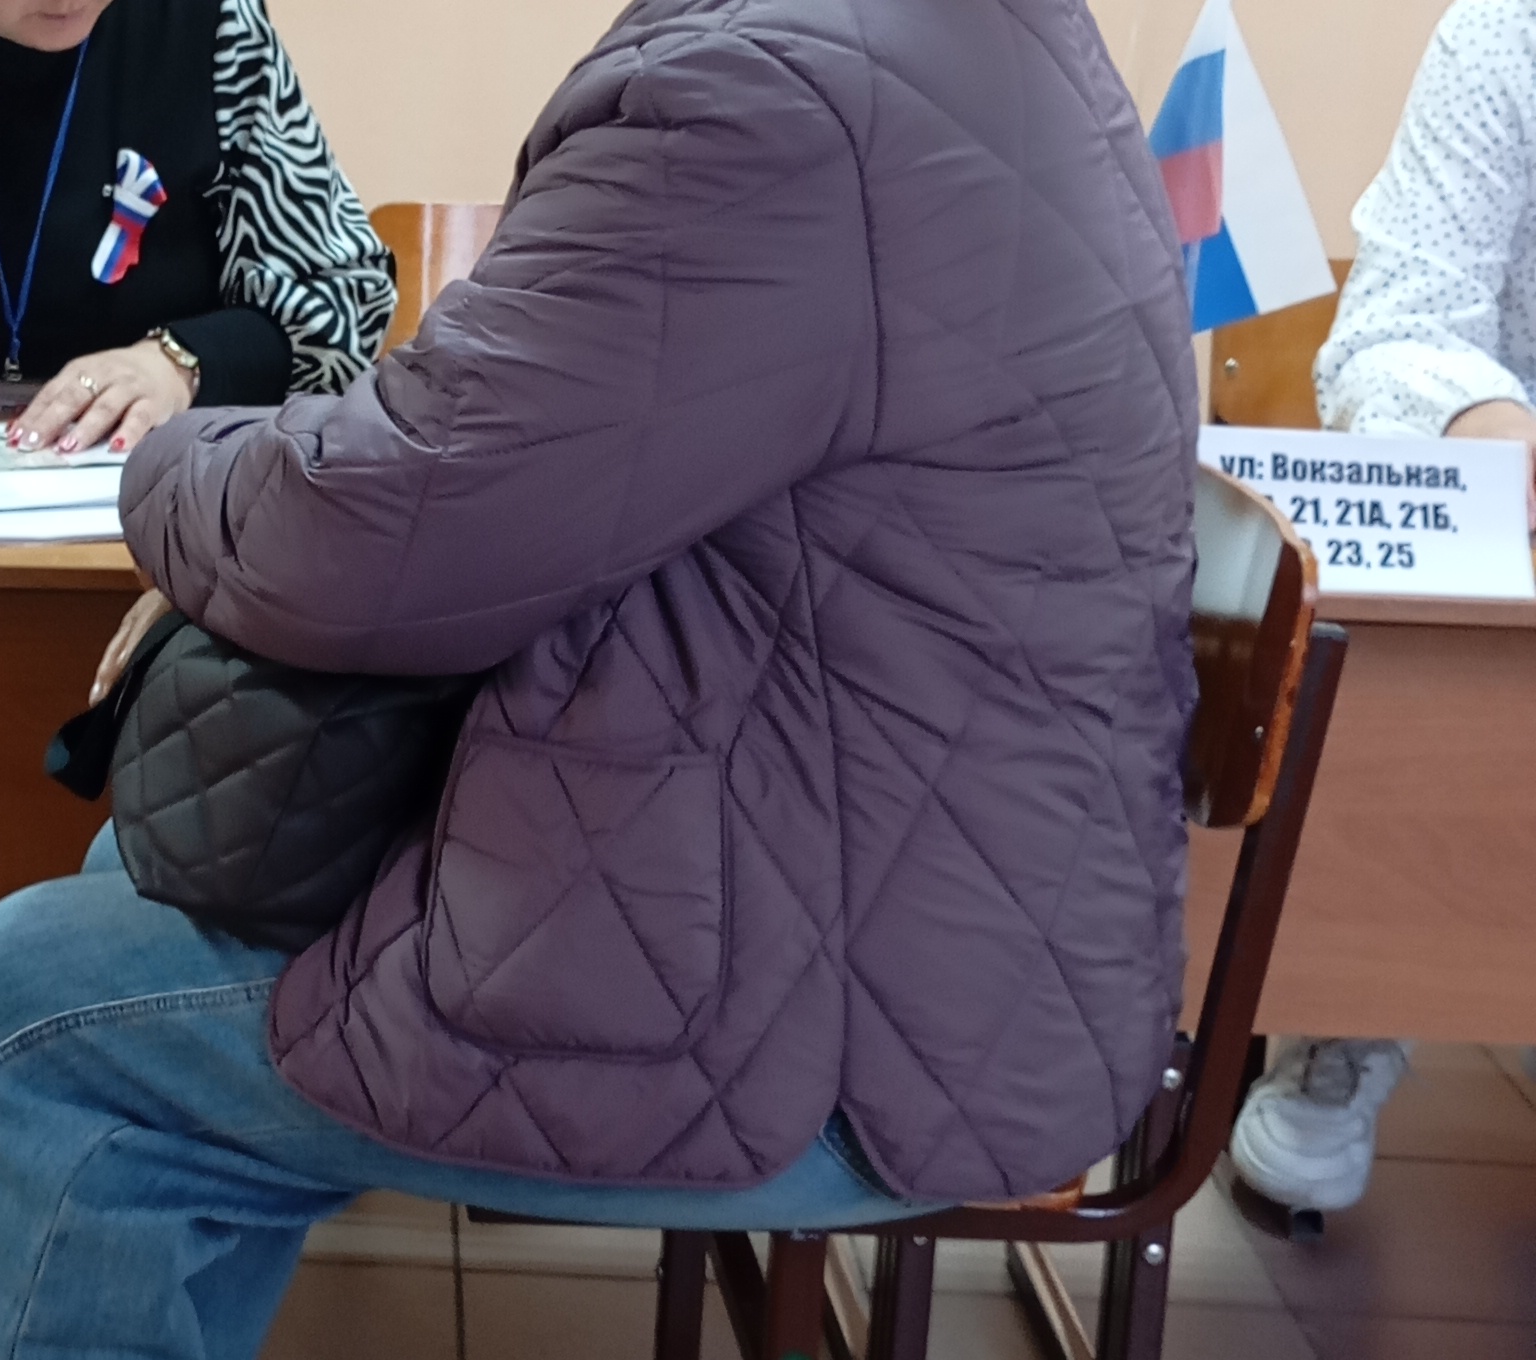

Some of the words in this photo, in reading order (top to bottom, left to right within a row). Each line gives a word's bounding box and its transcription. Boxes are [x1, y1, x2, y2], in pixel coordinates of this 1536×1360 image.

[1270, 452, 1468, 491] Вокзальная,
[1290, 496, 1329, 527] 21,
[1335, 498, 1392, 529] 21А,
[1398, 501, 1458, 533] 21Б,
[1378, 541, 1415, 569] 25
